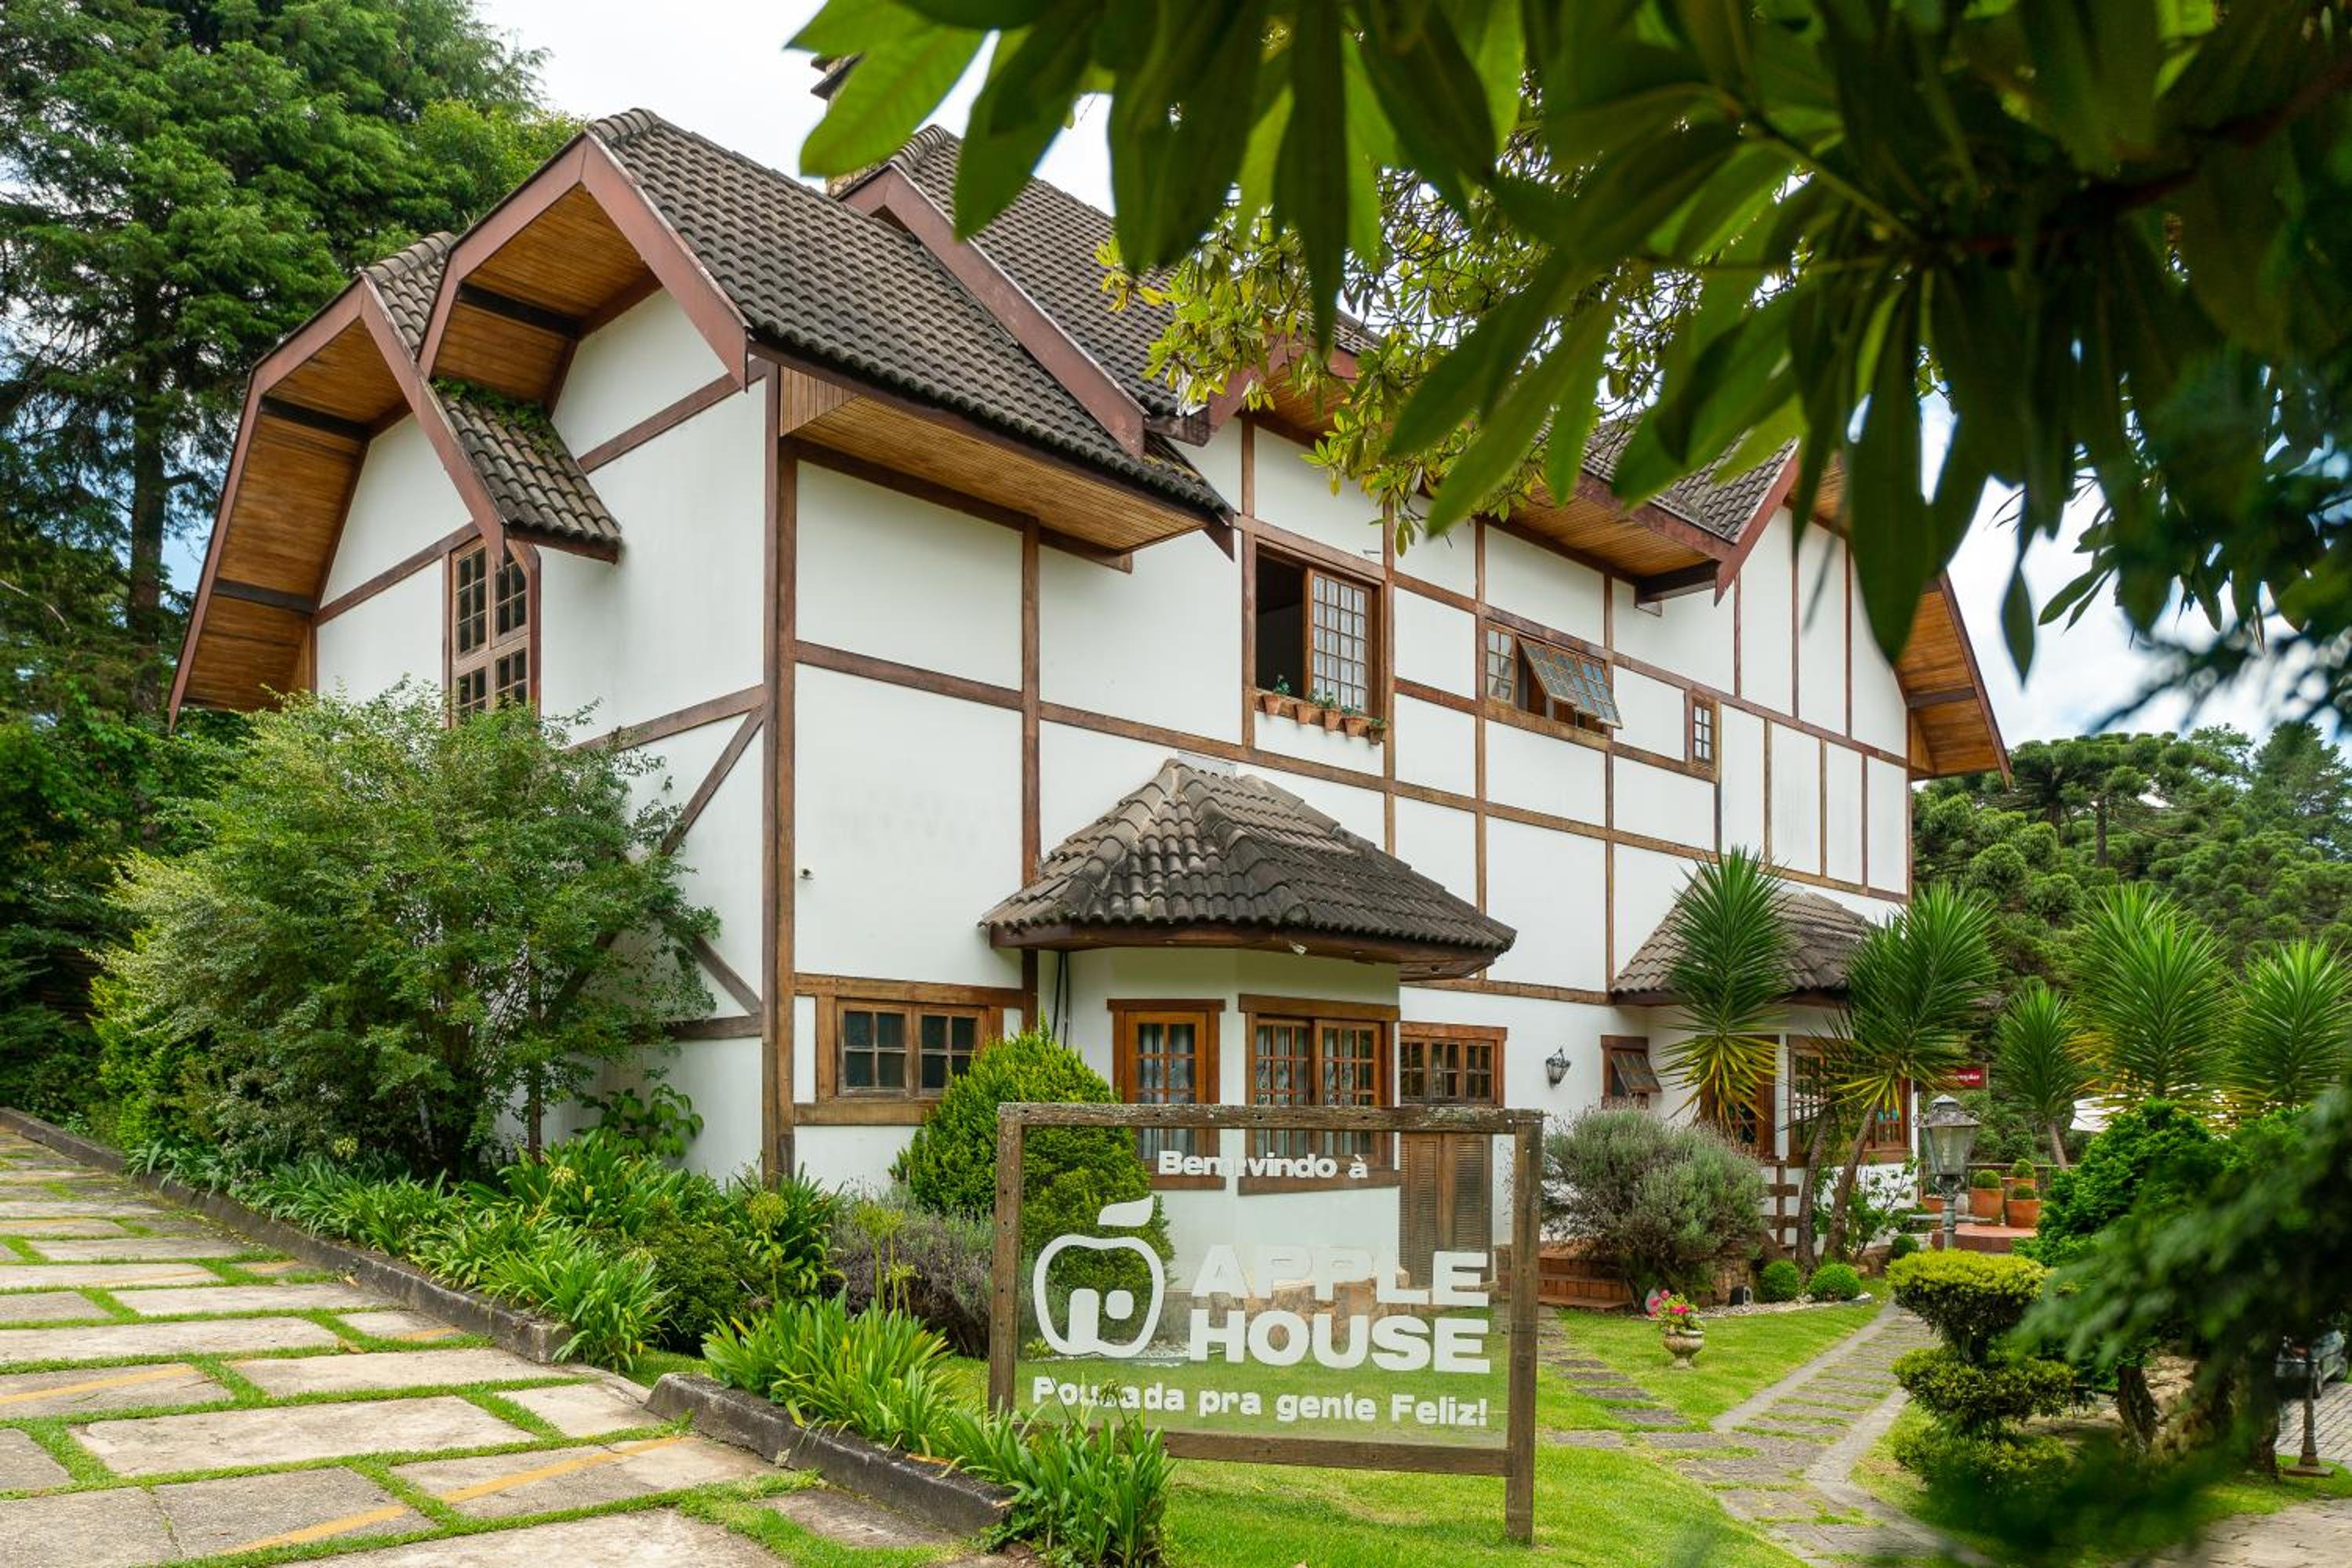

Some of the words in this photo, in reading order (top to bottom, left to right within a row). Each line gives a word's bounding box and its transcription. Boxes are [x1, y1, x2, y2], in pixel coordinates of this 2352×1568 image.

[1158, 1150, 1338, 1178] Bemvindo
[1348, 1153, 1368, 1179] à
[1191, 1244, 1489, 1307] APPLE
[1189, 1308, 1490, 1374] HOUSE
[1199, 1389, 1261, 1417] pra
[1276, 1392, 1377, 1422] gente
[1391, 1392, 1487, 1426] Feliz!
